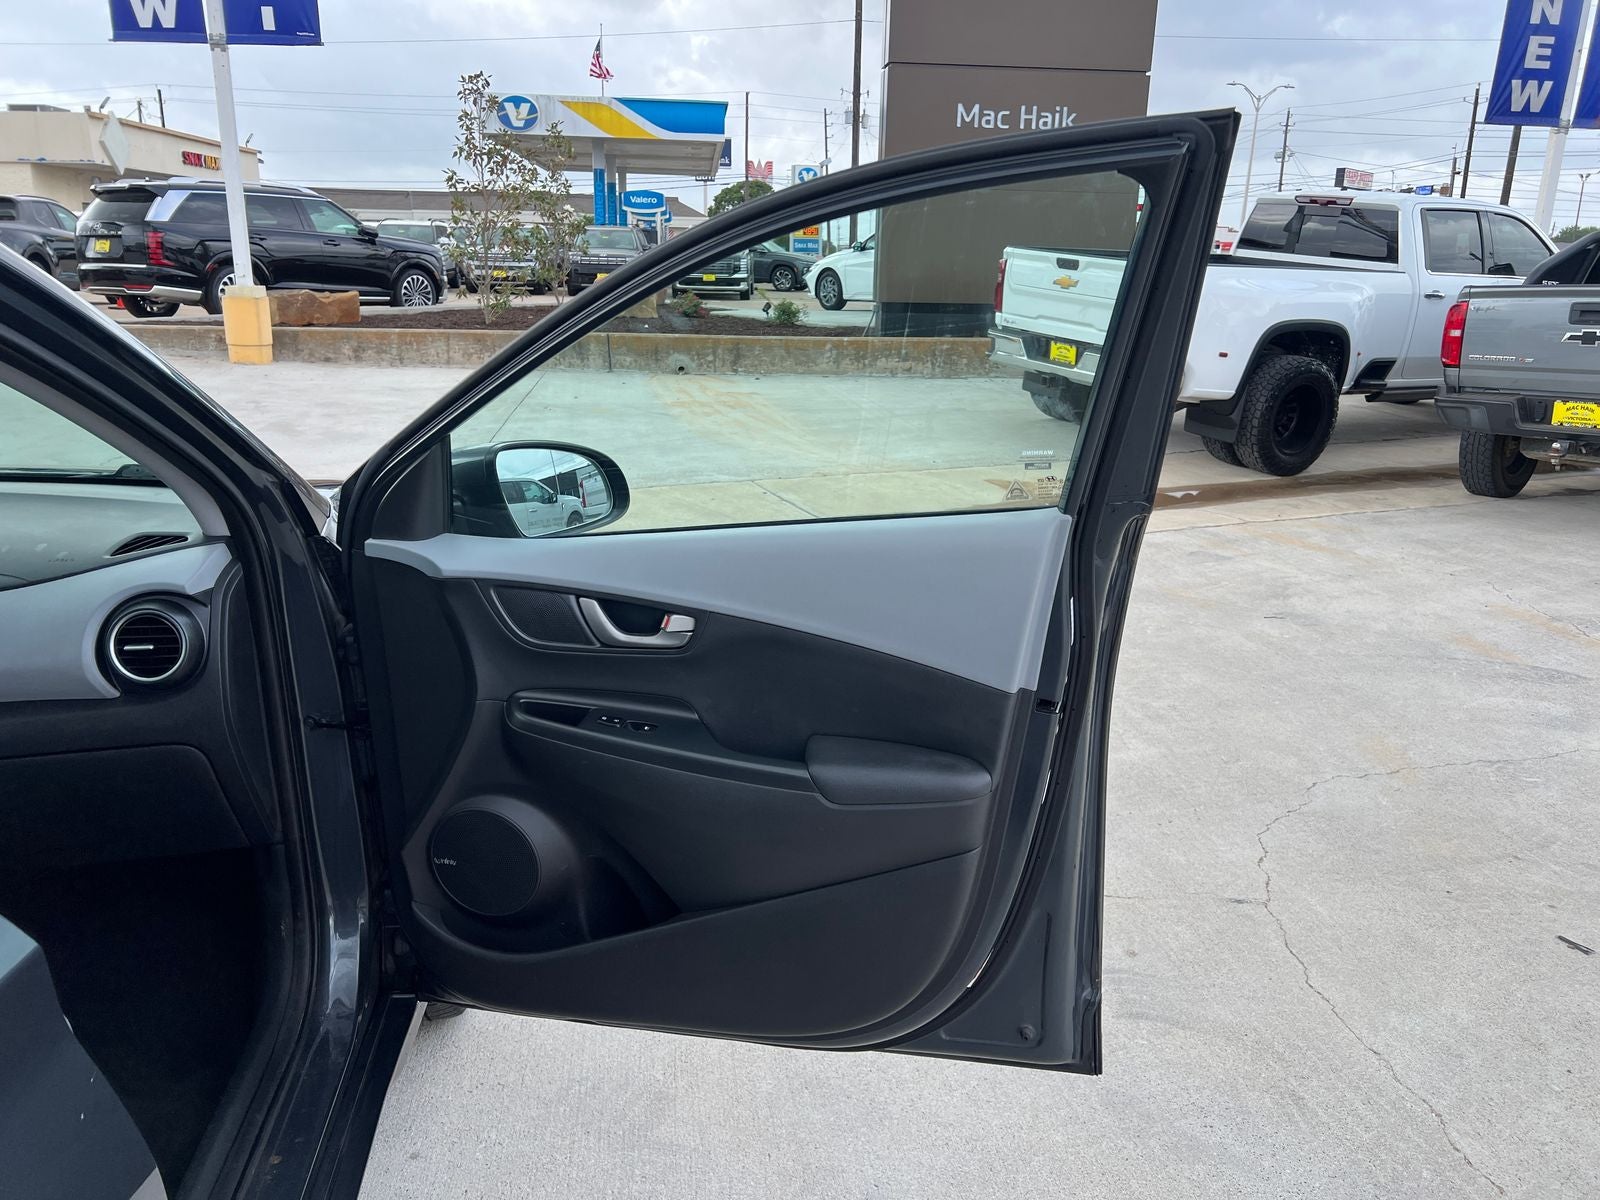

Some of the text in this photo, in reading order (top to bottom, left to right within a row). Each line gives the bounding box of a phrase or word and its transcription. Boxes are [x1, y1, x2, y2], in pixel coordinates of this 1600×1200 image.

[1510, 0, 1563, 113] NEW
[956, 103, 1077, 130] Mac Haik
[630, 195, 657, 204] Valero
[1468, 354, 1517, 363] COLORADO
